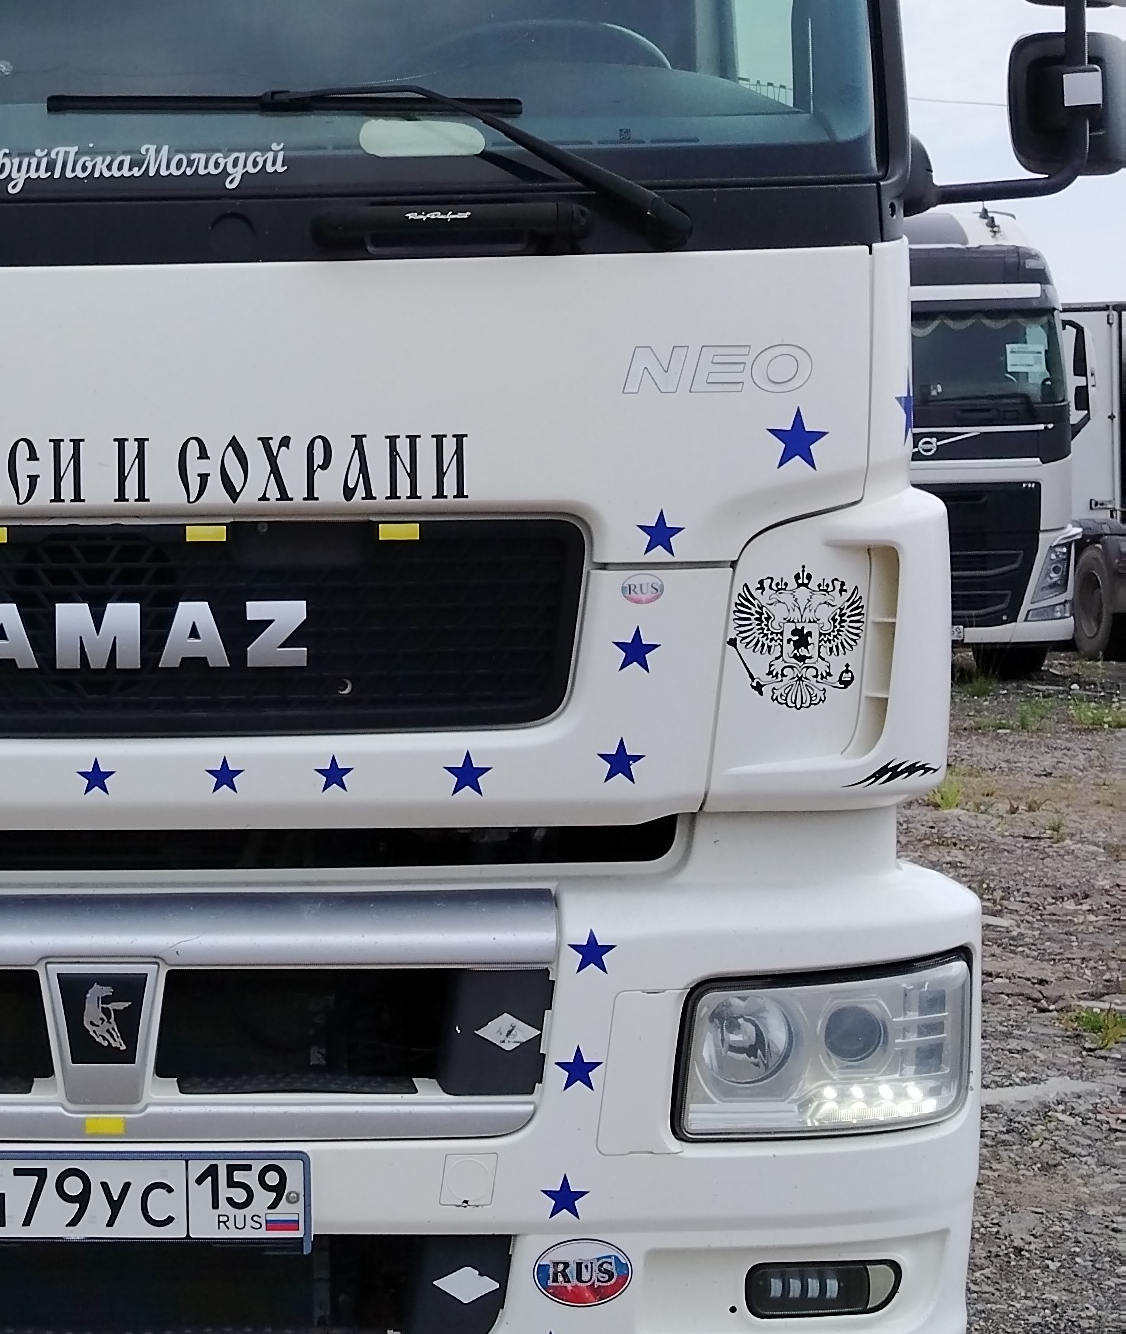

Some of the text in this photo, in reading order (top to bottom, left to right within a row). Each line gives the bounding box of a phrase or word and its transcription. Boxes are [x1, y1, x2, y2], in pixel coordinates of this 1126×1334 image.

[621, 343, 813, 394] NEO
[113, 437, 150, 503] И
[177, 434, 469, 504] СОХРАНИ
[626, 582, 659, 595] RUS
[194, 1163, 288, 1210] 159
[217, 1214, 263, 1230] RUS
[550, 1260, 615, 1284] RUS
